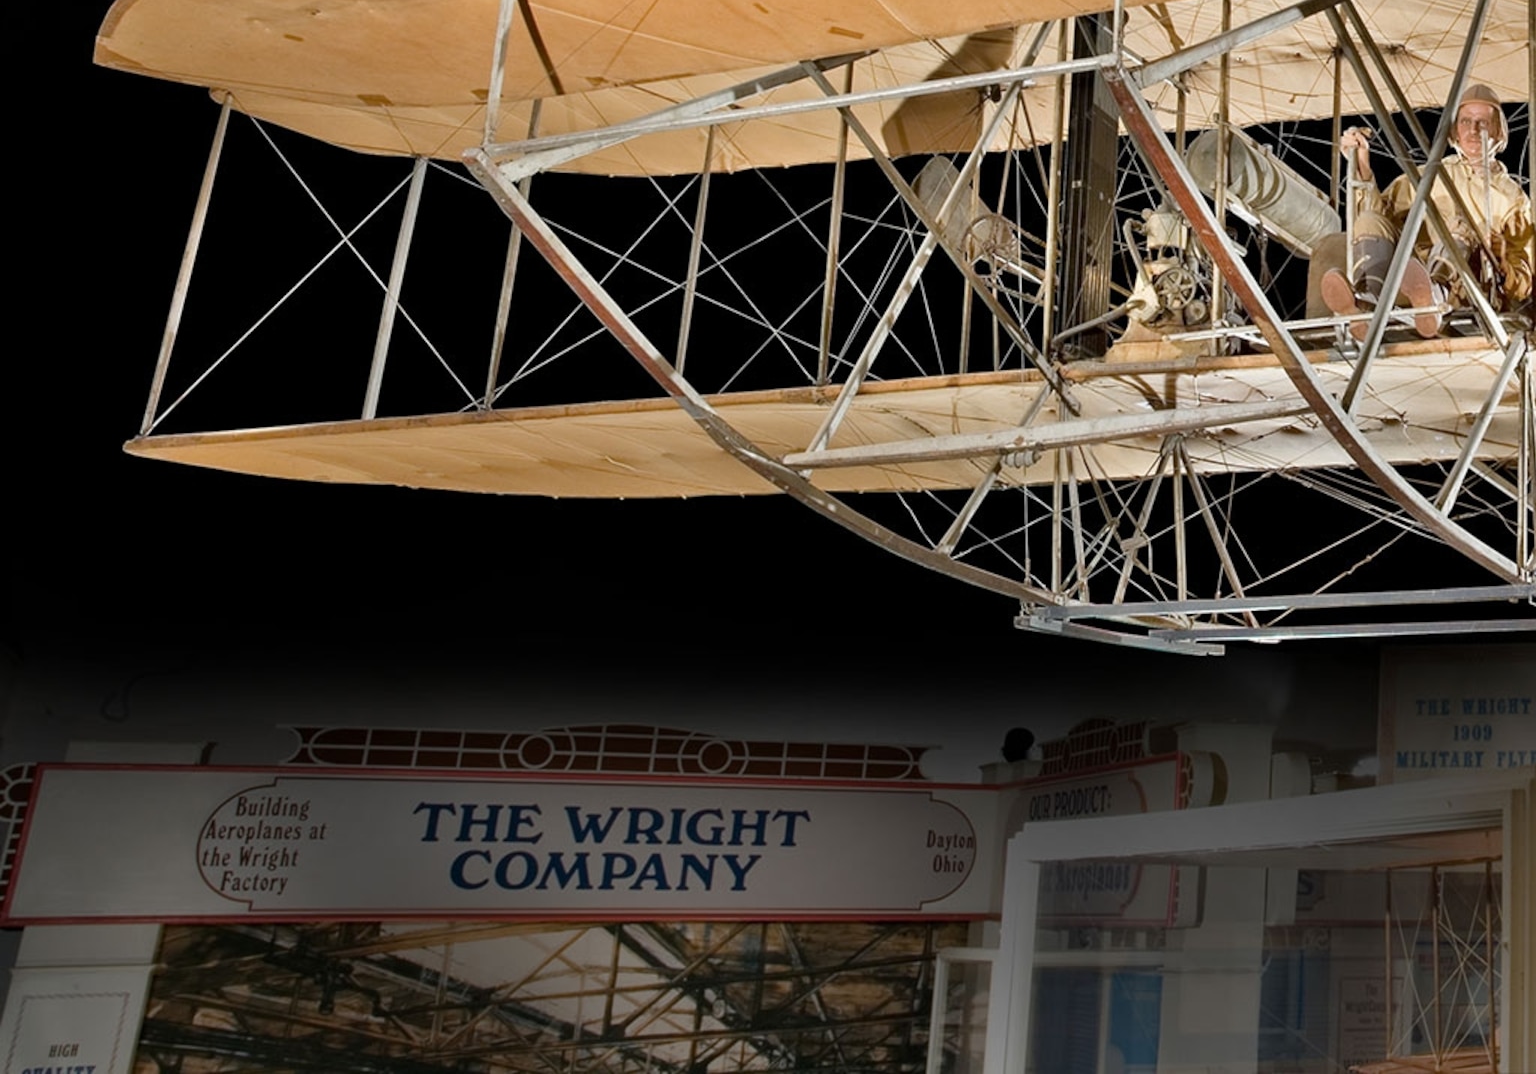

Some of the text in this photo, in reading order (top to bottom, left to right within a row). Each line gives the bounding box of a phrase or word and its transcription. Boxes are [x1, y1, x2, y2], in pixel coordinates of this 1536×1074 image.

[1416, 698, 1532, 715] THE WRIGHT
[1453, 725, 1493, 741] 1909
[1396, 751, 1484, 768] MILITARY
[235, 796, 311, 821] Building
[1029, 785, 1112, 820] OUR PRODUCT:
[205, 819, 327, 844] Aeroplanes at
[413, 802, 811, 846] THE WRIGHT
[926, 830, 974, 851] Dayton
[202, 846, 299, 871] the Wright
[450, 850, 761, 891] COMPANY
[933, 854, 965, 873] Ohio
[220, 871, 288, 895] Factory
[48, 1043, 79, 1058] HIGH
